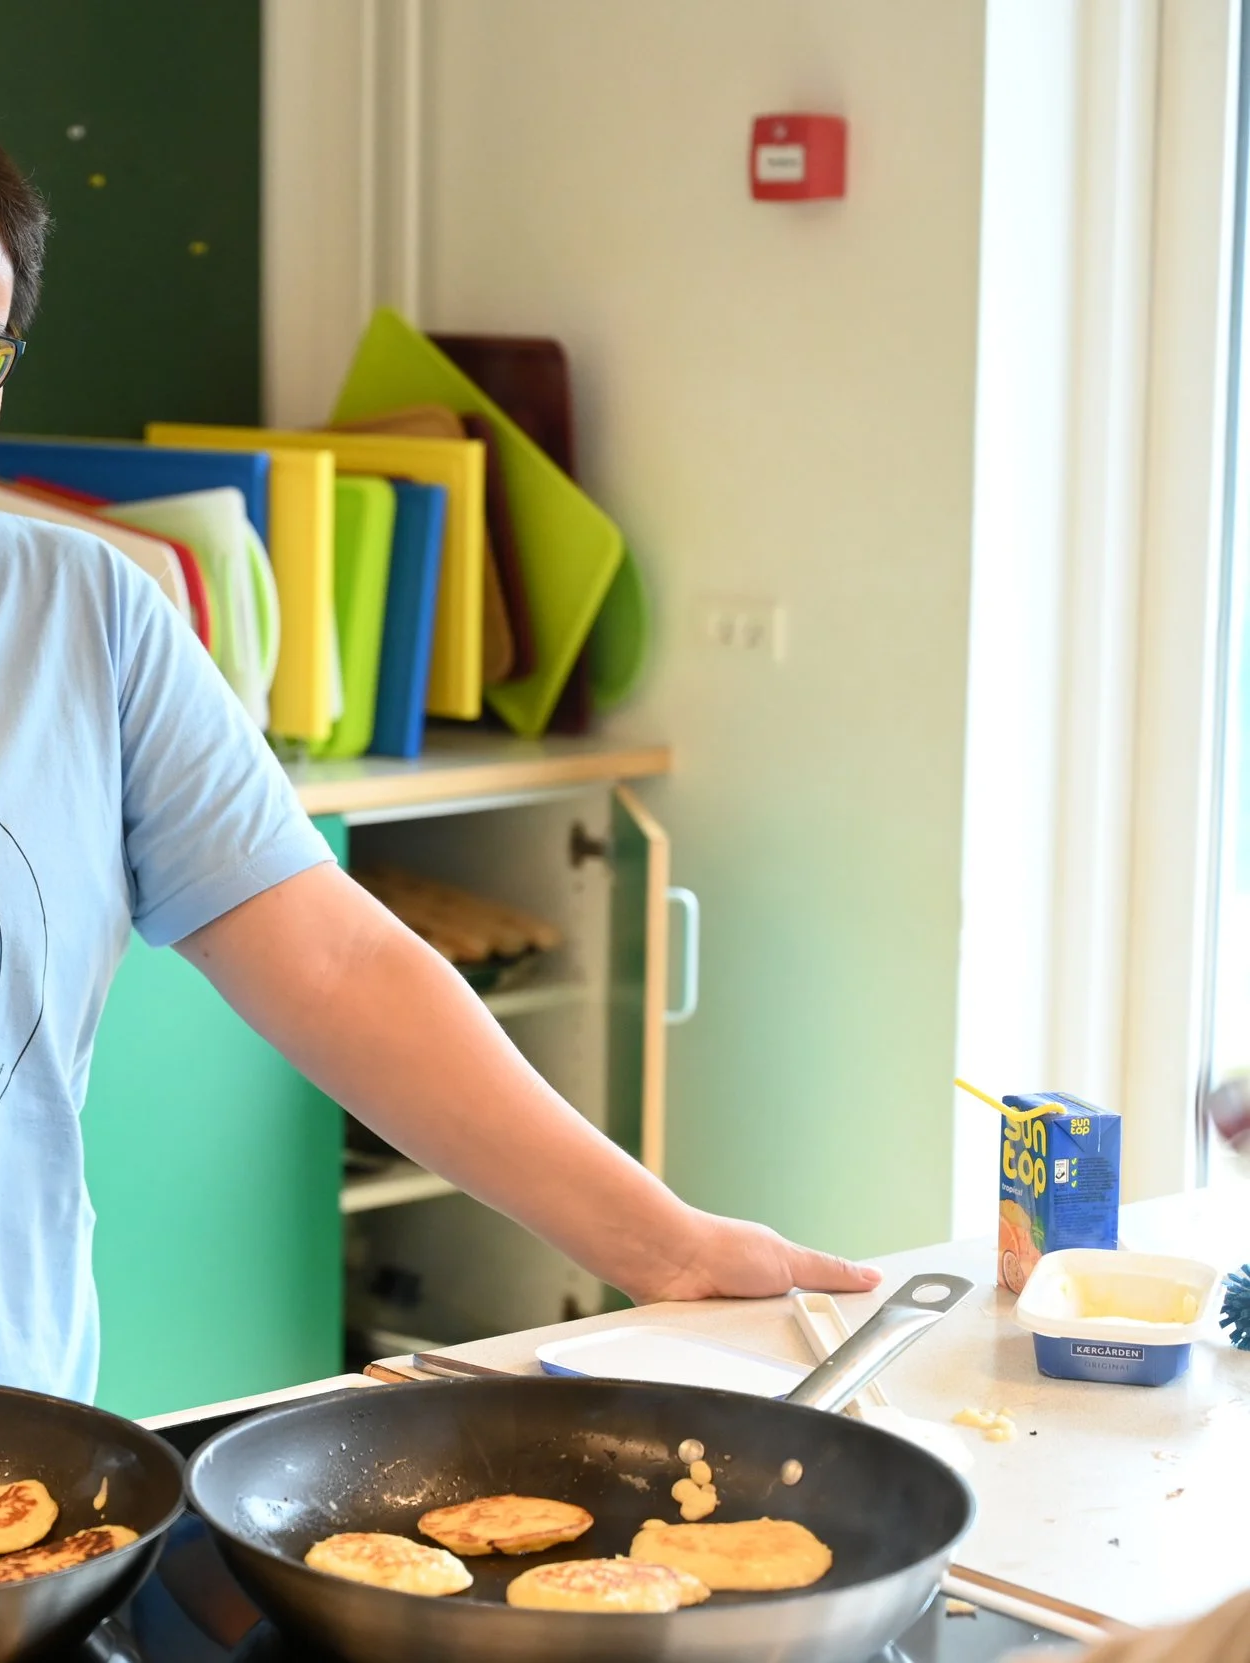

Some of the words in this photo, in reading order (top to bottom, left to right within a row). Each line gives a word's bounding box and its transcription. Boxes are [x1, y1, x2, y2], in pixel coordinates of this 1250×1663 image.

[1070, 1118, 1090, 1127] sun
[1004, 1106, 1047, 1157] sun
[1070, 1126, 1090, 1136] top
[1002, 1139, 1047, 1199] top
[1001, 1182, 1023, 1197] tropical
[1076, 1345, 1139, 1358] KÆRGÅRDEN
